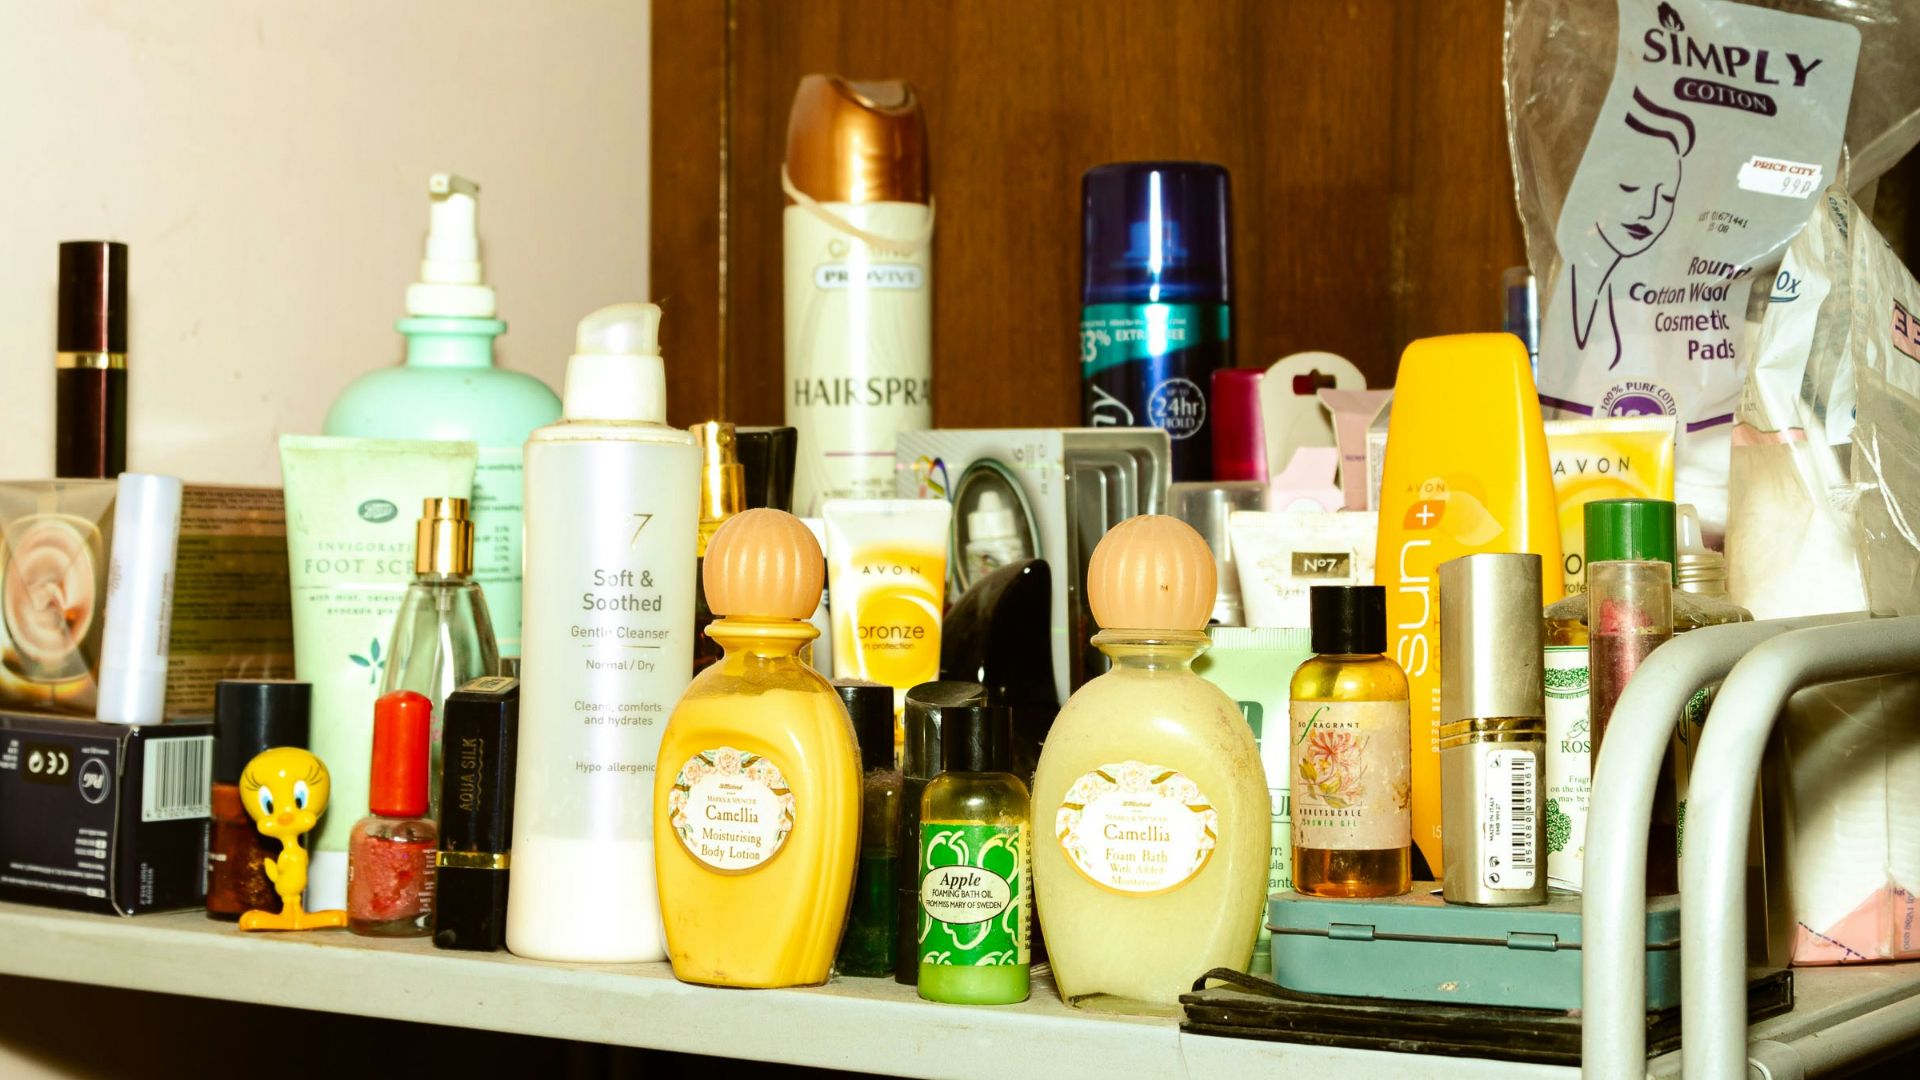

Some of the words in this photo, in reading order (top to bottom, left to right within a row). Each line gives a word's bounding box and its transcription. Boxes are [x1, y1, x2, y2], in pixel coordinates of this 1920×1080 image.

[1643, 28, 1823, 87] SIMPLY
[1683, 81, 1767, 112] COTTON
[1753, 160, 1787, 172] PRICE
[1789, 166, 1816, 176] CITY
[824, 269, 916, 283] PRVIVE
[1688, 256, 1751, 280] Round
[1629, 281, 1684, 305] Cotton
[1690, 283, 1731, 302] Wool
[1655, 309, 1730, 332] Cosmetic
[1688, 340, 1735, 360] Pads
[1155, 397, 1200, 417] 24hr
[1626, 382, 1657, 393] PURE
[1657, 388, 1677, 416] COTTO
[1162, 417, 1195, 429] HOLD
[1554, 456, 1630, 474] AVON
[1407, 483, 1446, 493] AVON
[305, 559, 366, 575] FOOT
[862, 566, 921, 575] AVON
[593, 569, 634, 587] Soft
[640, 570, 654, 587] &
[582, 593, 663, 612] Soothed
[1397, 540, 1431, 677] sun
[616, 626, 669, 639] Cleanser
[586, 659, 627, 670] Normal
[637, 660, 655, 672] Dry
[618, 702, 662, 713] comforts
[584, 715, 604, 725] and
[608, 715, 653, 727] hydrates
[461, 738, 477, 772] SILK
[459, 774, 475, 812] AQUA
[705, 805, 759, 823] Camellia
[1300, 808, 1361, 817] HONEYSUCKLE
[702, 827, 762, 847] Moisturising
[1104, 823, 1170, 841] Camellia
[701, 845, 725, 862] Body
[729, 846, 760, 860] Lotion
[1106, 848, 1136, 861] Foam
[1142, 849, 1168, 863] Bath
[939, 872, 981, 889] Apple
[932, 889, 960, 898] FOAMING
[961, 890, 980, 898] BATH
[981, 890, 993, 898] OIL
